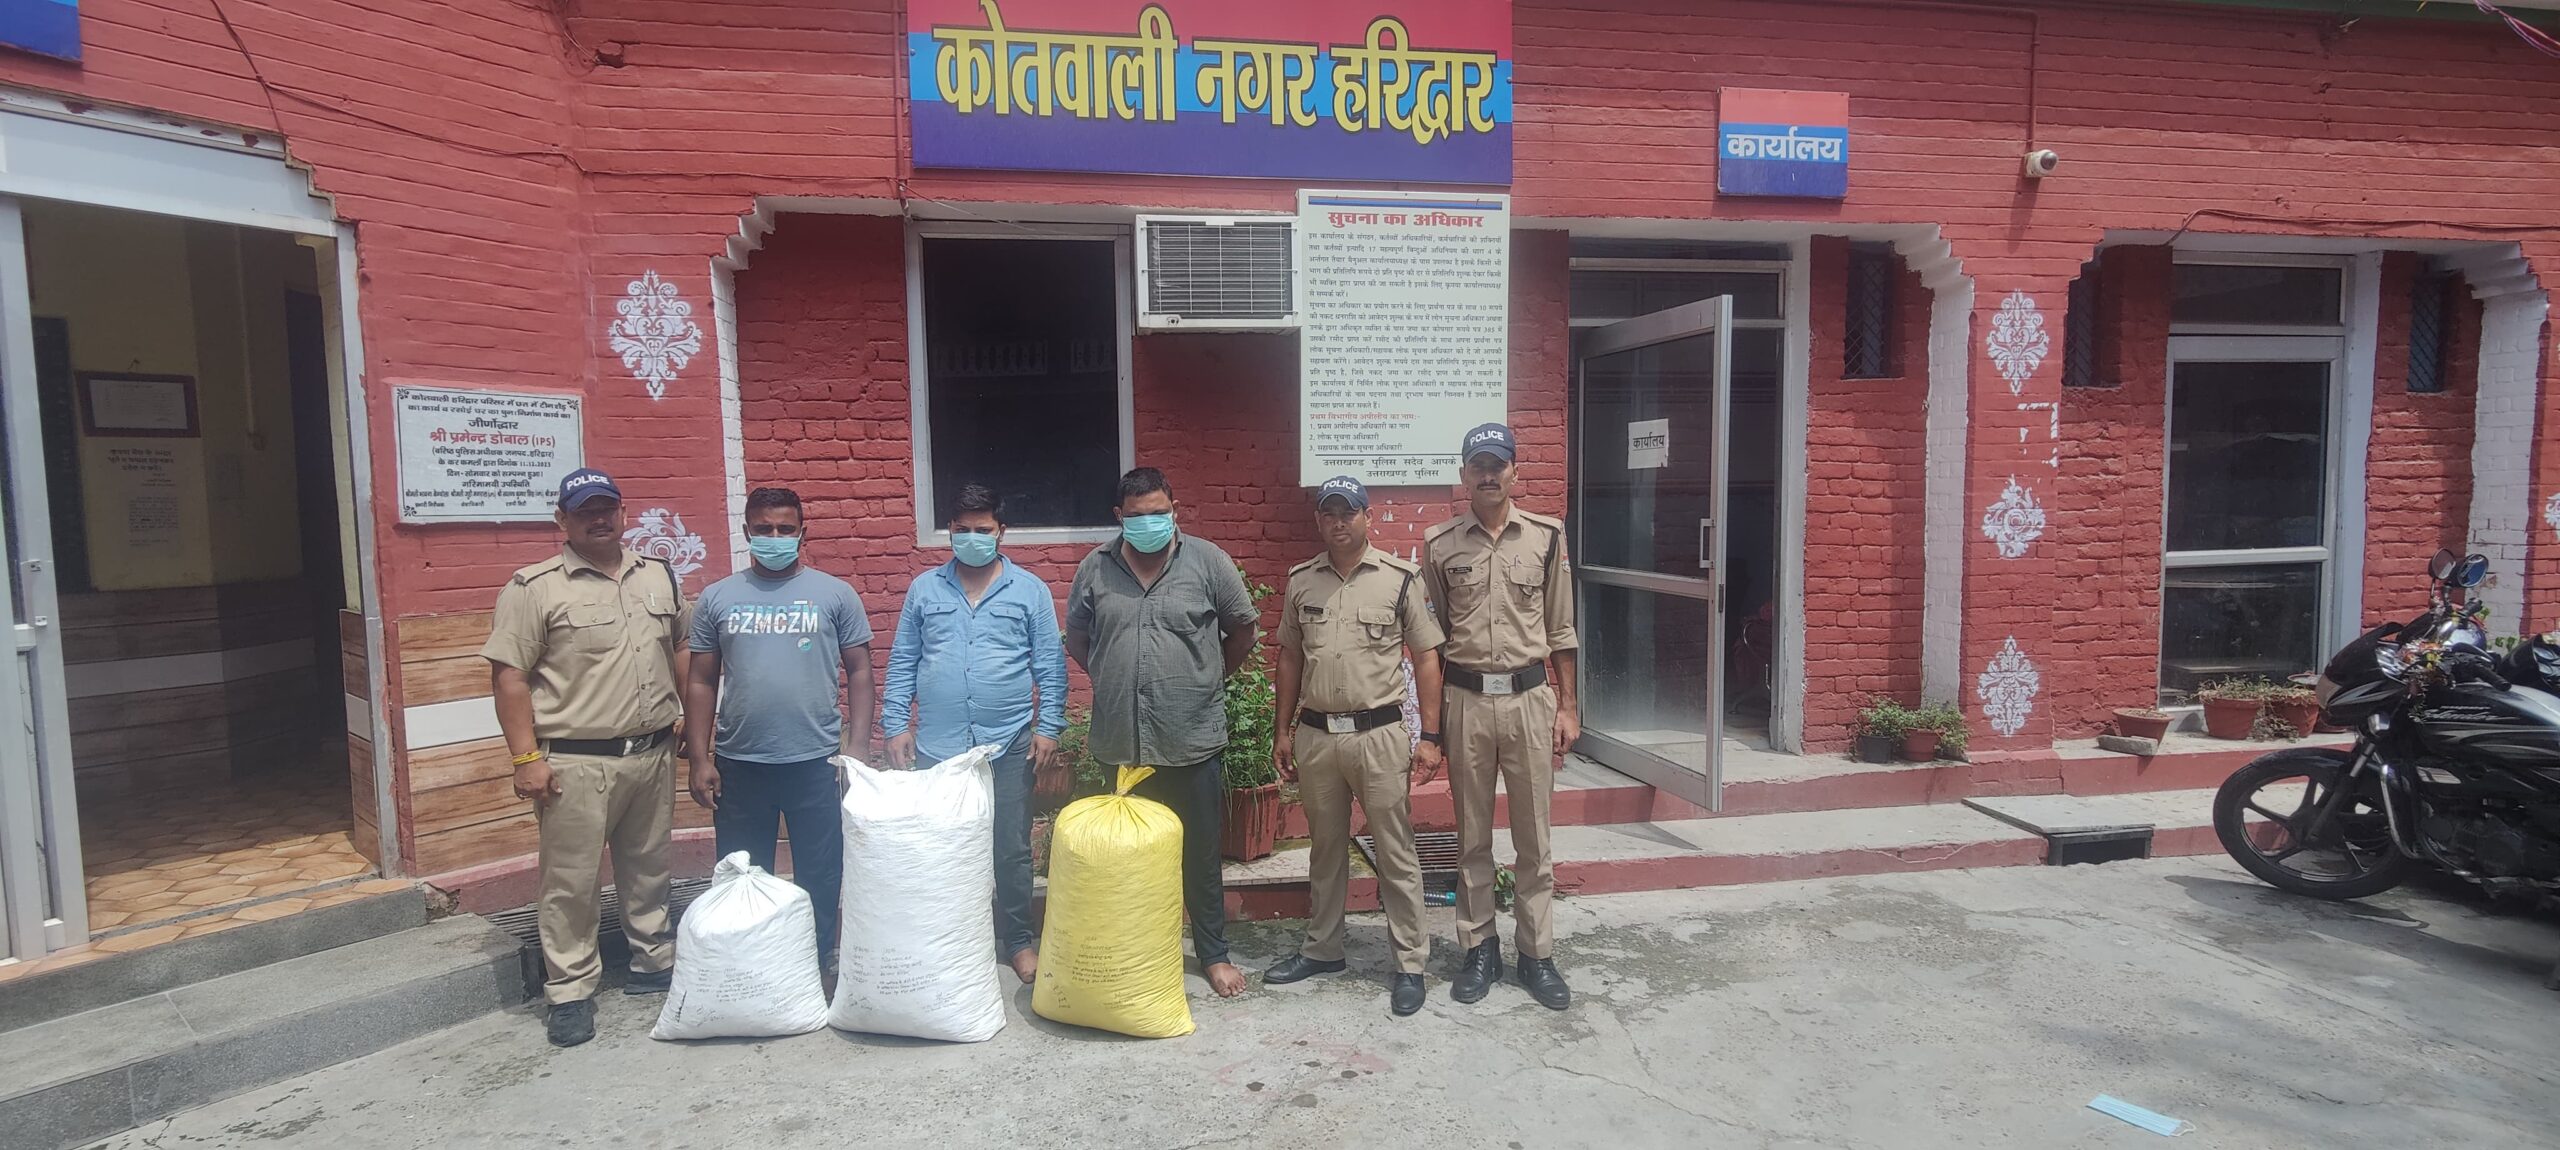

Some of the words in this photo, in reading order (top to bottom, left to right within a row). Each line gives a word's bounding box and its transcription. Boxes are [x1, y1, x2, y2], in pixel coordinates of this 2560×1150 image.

[930, 0, 1180, 122] कोतवाली
[1191, 35, 1320, 128] नगर
[1328, 15, 1498, 144] हरिद्वार
[1726, 126, 1843, 161] कार्यालय
[1382, 213, 1408, 226] का
[1413, 212, 1485, 227] अधिकार
[411, 394, 449, 402] कोतवाली
[452, 396, 478, 404] हरिद्वार
[481, 397, 505, 406] परिसर
[1310, 411, 1326, 420] प्रथम
[1328, 411, 1358, 420] विभागीय
[468, 417, 519, 429] जीर्णोद्धार
[1360, 421, 1387, 429] अधिकारी
[430, 428, 447, 442] श्री
[450, 429, 488, 444] प्रमेन्द्र
[532, 434, 555, 448] (IPS)
[1317, 431, 1332, 440] लोक
[1333, 434, 1351, 443] सूचना
[1470, 430, 1504, 446] POLICE
[1633, 431, 1665, 448] कार्यालय
[455, 446, 475, 457] पुलिस
[1357, 444, 1374, 454] सूचना
[1376, 442, 1402, 450] अधिकारी
[1372, 457, 1396, 468] पुलिस
[1432, 456, 1457, 465] आपके
[465, 469, 490, 477] सोमवार
[1414, 468, 1439, 479] पुलिस
[462, 479, 499, 487] गरिमामयी
[501, 479, 530, 487] उपस्थिति
[567, 474, 609, 490] POLICE
[1323, 479, 1359, 493] POLICE
[727, 611, 818, 634] CZMCZM
